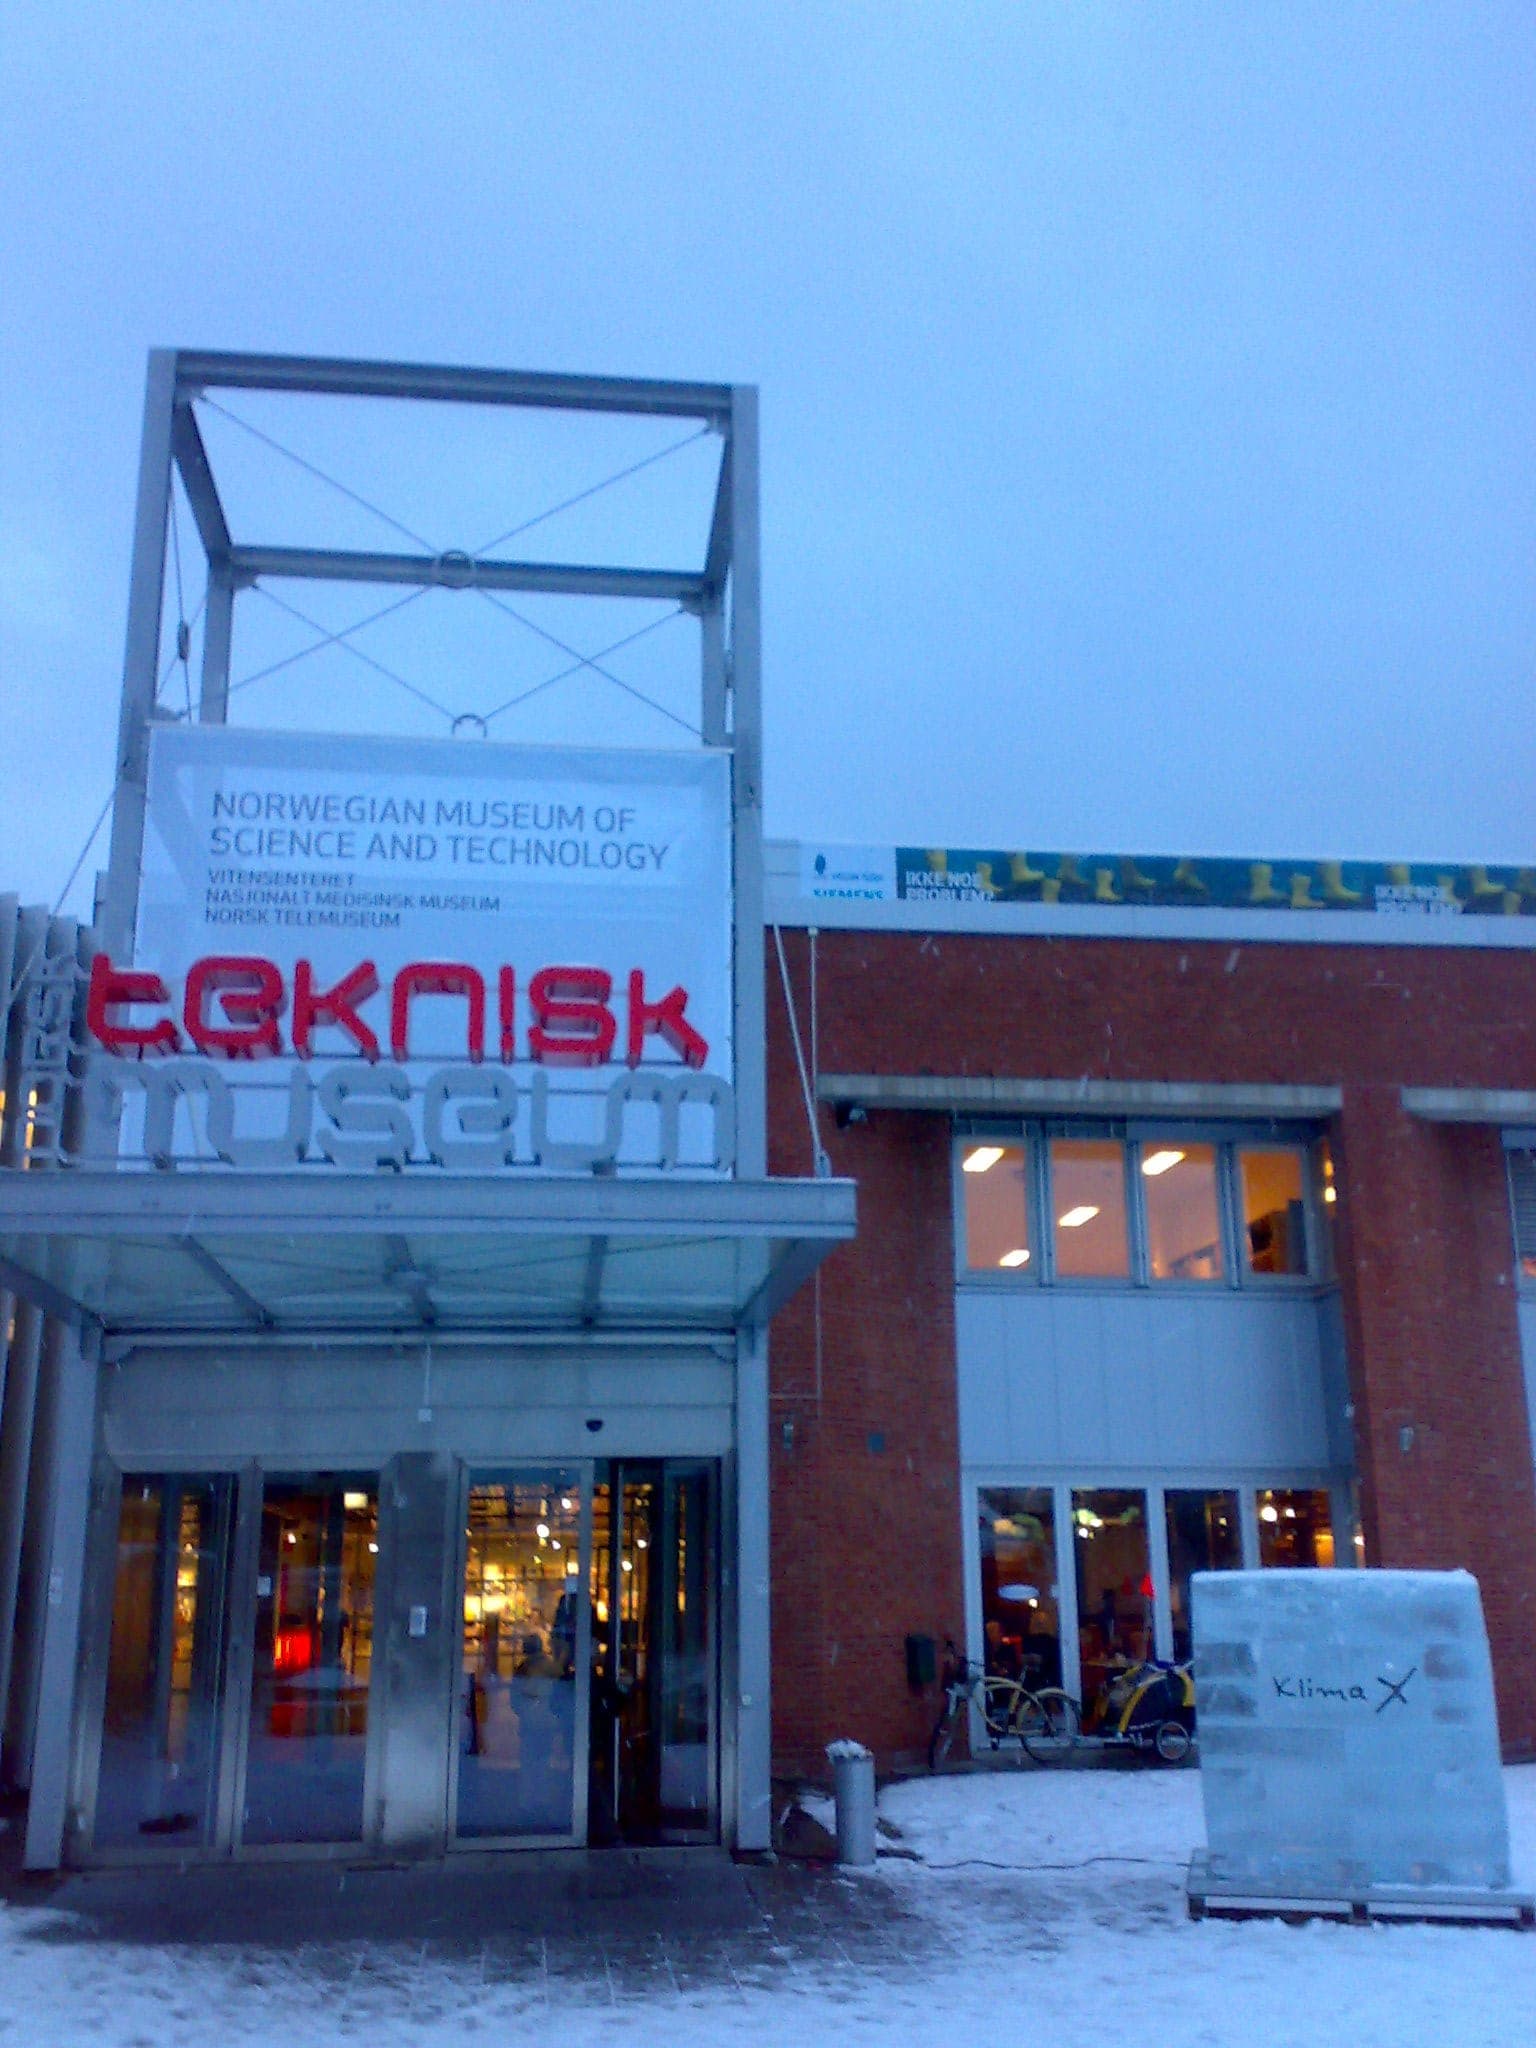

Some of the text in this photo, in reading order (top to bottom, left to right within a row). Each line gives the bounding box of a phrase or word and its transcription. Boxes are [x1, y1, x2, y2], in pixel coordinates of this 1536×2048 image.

[212, 790, 637, 833] NORWEGIAN MUSEUM OF
[209, 825, 669, 870] SCIENCE AND TECHNOLOGY
[206, 886, 311, 906] NASJONALT
[419, 893, 501, 912] MUSEUM
[207, 868, 354, 888] VITENSENTERET
[205, 905, 400, 928] NORSK TELEMUSEUM
[86, 953, 710, 1071] teknisk
[82, 1061, 735, 1176] museum
[1272, 1667, 1418, 1714] Klima X
